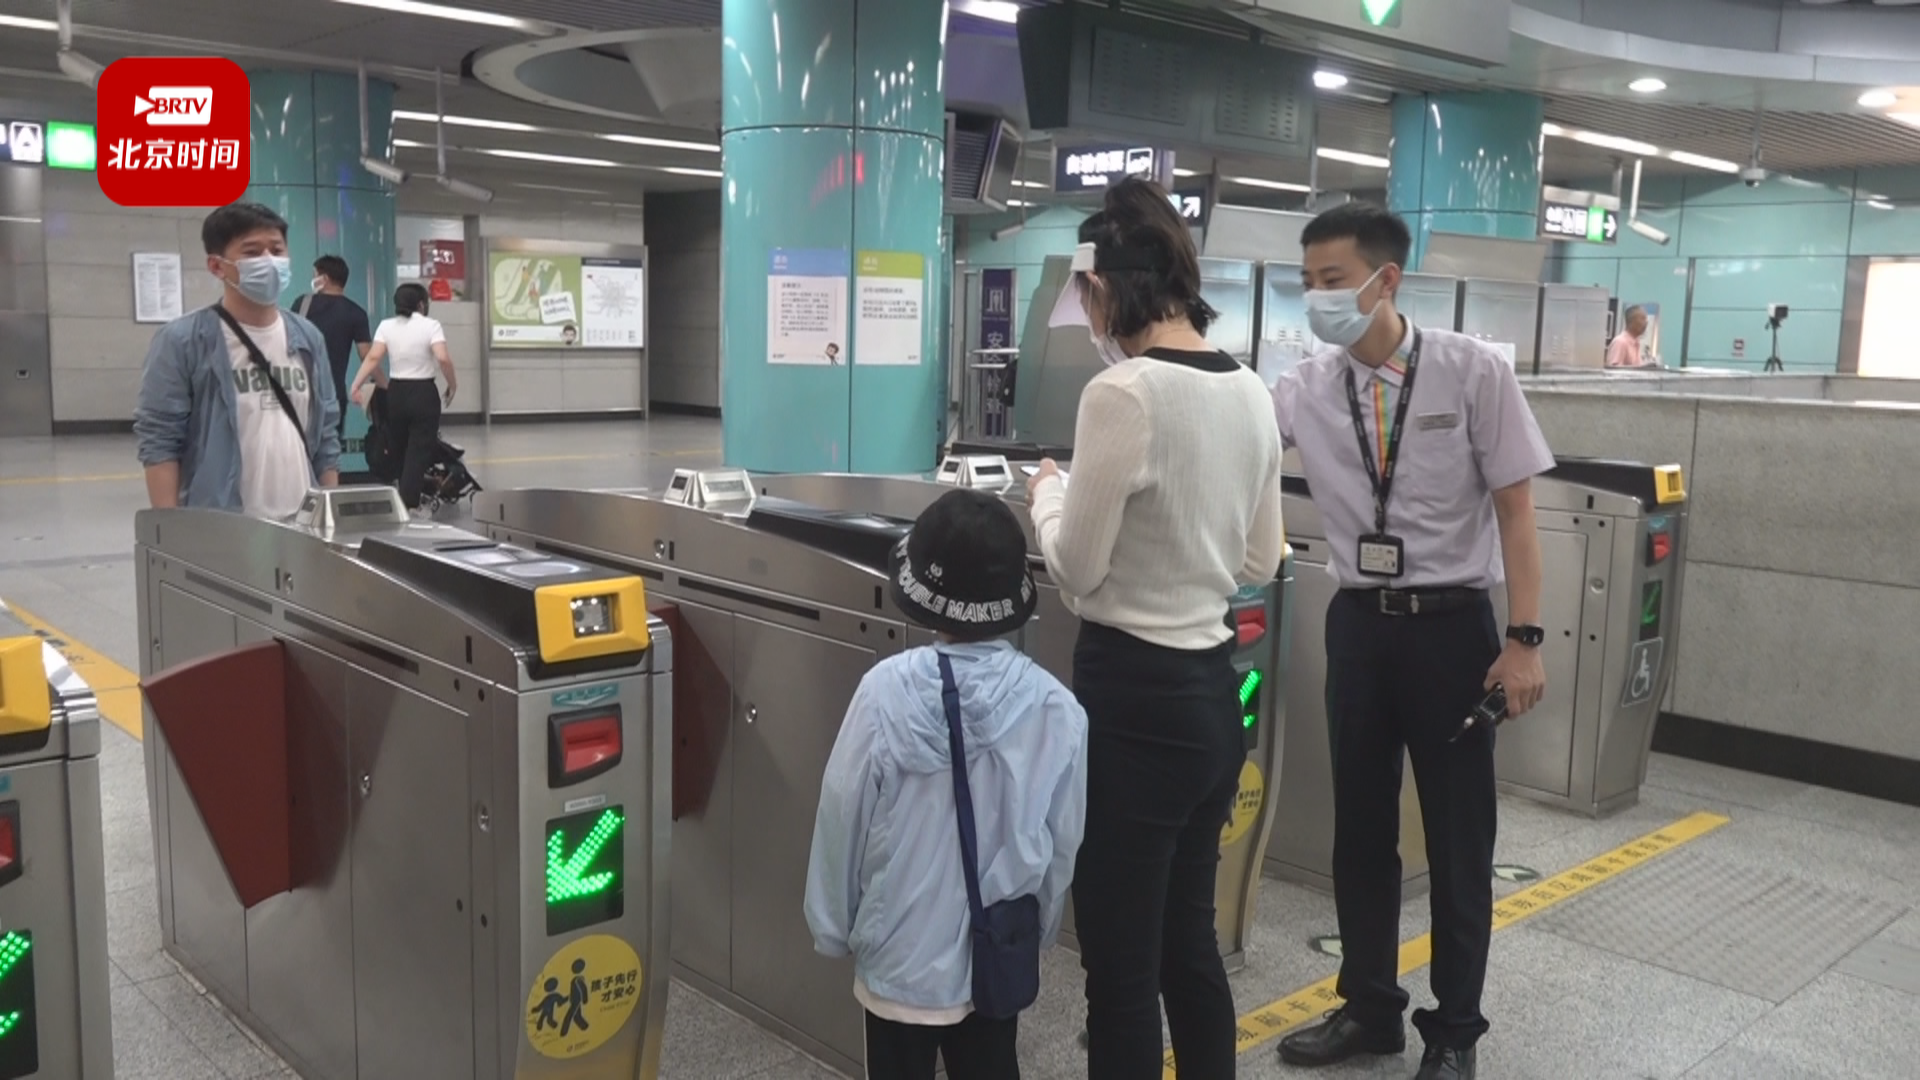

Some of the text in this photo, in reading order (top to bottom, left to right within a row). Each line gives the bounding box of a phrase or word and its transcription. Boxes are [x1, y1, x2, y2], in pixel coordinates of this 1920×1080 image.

[232, 366, 307, 394] vaue
[945, 598, 1015, 623] MAKER
[591, 969, 638, 993] 孩子先行
